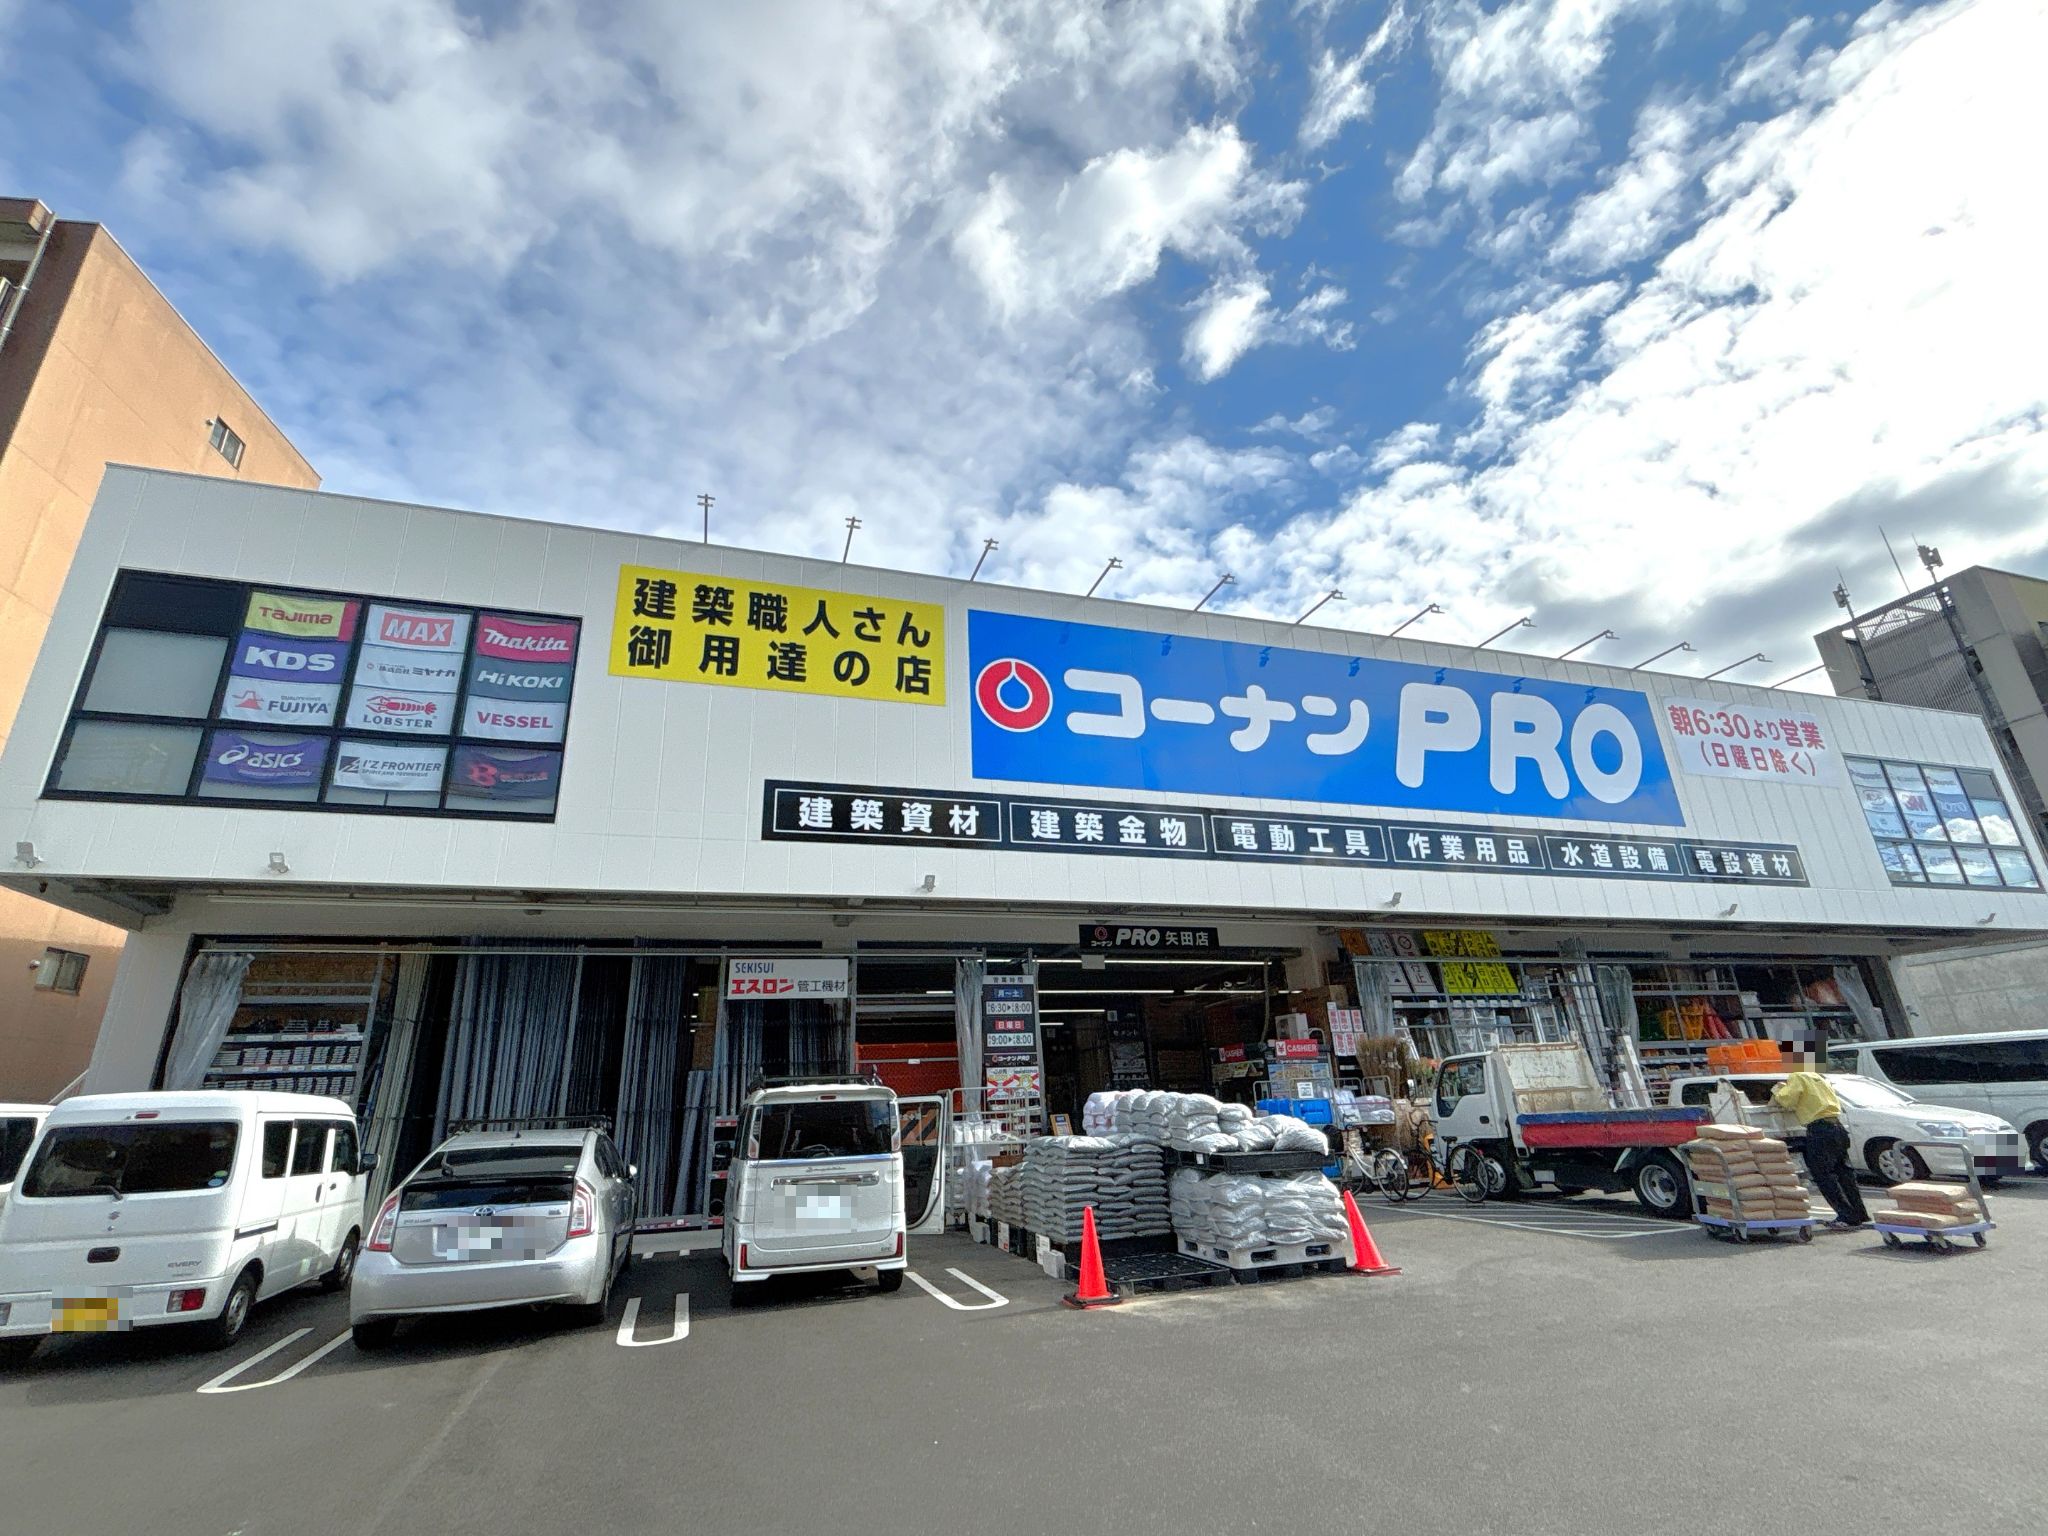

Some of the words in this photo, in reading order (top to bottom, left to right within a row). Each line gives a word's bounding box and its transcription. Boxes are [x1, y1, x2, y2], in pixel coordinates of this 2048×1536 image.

[631, 577, 931, 648] 建築職人さん
[384, 619, 450, 642] MAX
[244, 646, 335, 672] KDS
[627, 625, 931, 696] 御用達の店
[477, 670, 564, 689] HiKOKI
[267, 701, 329, 714] FUJIYA
[1062, 668, 1371, 756] コーナン
[363, 714, 433, 728] LOBSTER
[476, 711, 554, 729] VESSEL
[1667, 704, 1826, 750] 朝6:30より営業
[1395, 681, 1643, 804] PRO
[247, 752, 304, 769] asics
[381, 761, 442, 772] FRONTIER
[798, 796, 980, 837] 建築資材
[1029, 809, 1188, 848] 建築金物
[1230, 822, 1371, 857] 電動工具
[1406, 832, 1531, 864] 作業用品
[1560, 841, 1670, 871] 水道設備
[1695, 849, 1793, 877] 電設資材
[1115, 928, 1161, 946] PRO
[1165, 930, 1209, 947] 矢田店
[735, 962, 774, 974] SEKISUI
[731, 978, 795, 995] エスロン
[797, 979, 846, 993] 管工機材
[990, 1003, 1006, 1013] 6:30
[1014, 1003, 1031, 1012] 8:00
[991, 1035, 1008, 1045] 9:00
[1015, 1035, 1032, 1044] 8:00
[1286, 1043, 1317, 1053] CASHIER
